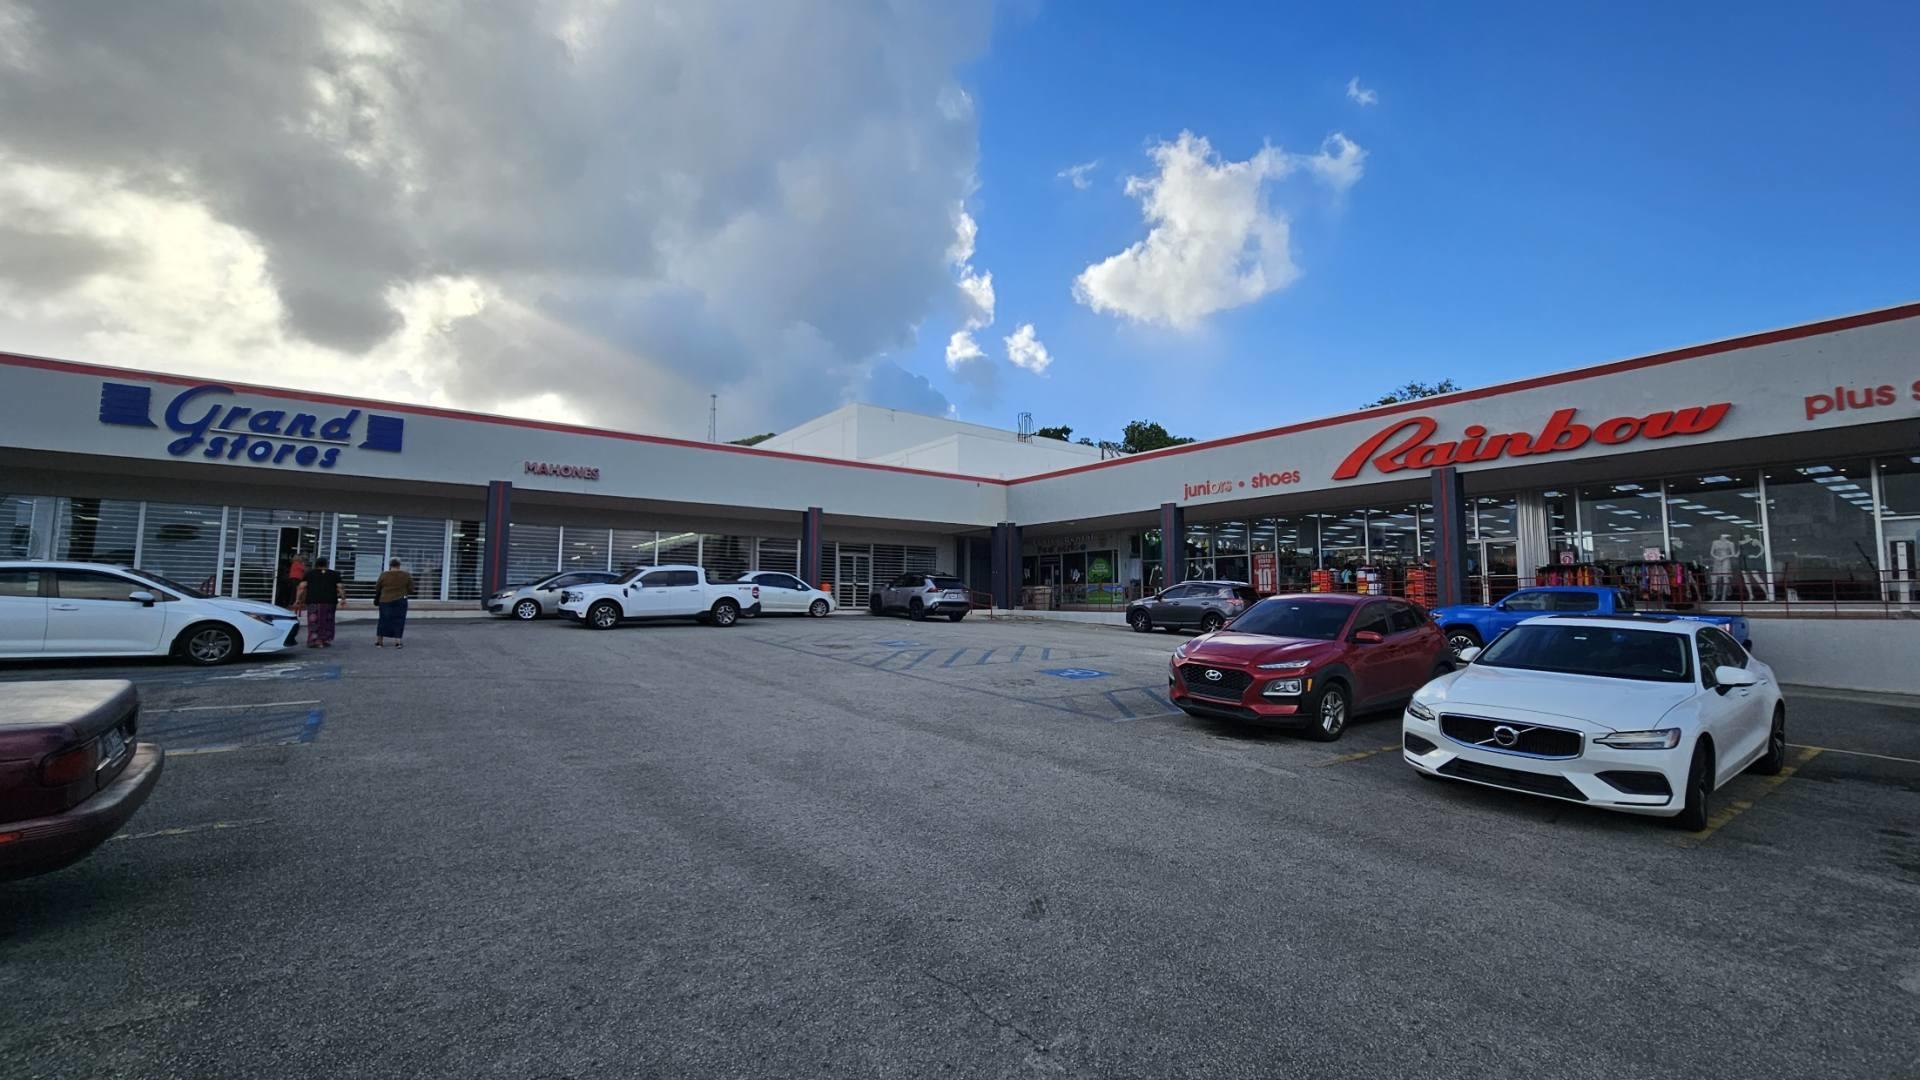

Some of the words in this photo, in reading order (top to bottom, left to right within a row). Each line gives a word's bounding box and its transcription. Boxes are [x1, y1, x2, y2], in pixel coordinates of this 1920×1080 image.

[165, 384, 361, 456] Grand
[1805, 384, 1897, 421] plus
[203, 432, 342, 469] stores
[1331, 402, 1732, 481] Rainbow
[524, 461, 600, 481] MAHONES
[1184, 480, 1233, 501] juniors
[1251, 470, 1301, 489] shoes
